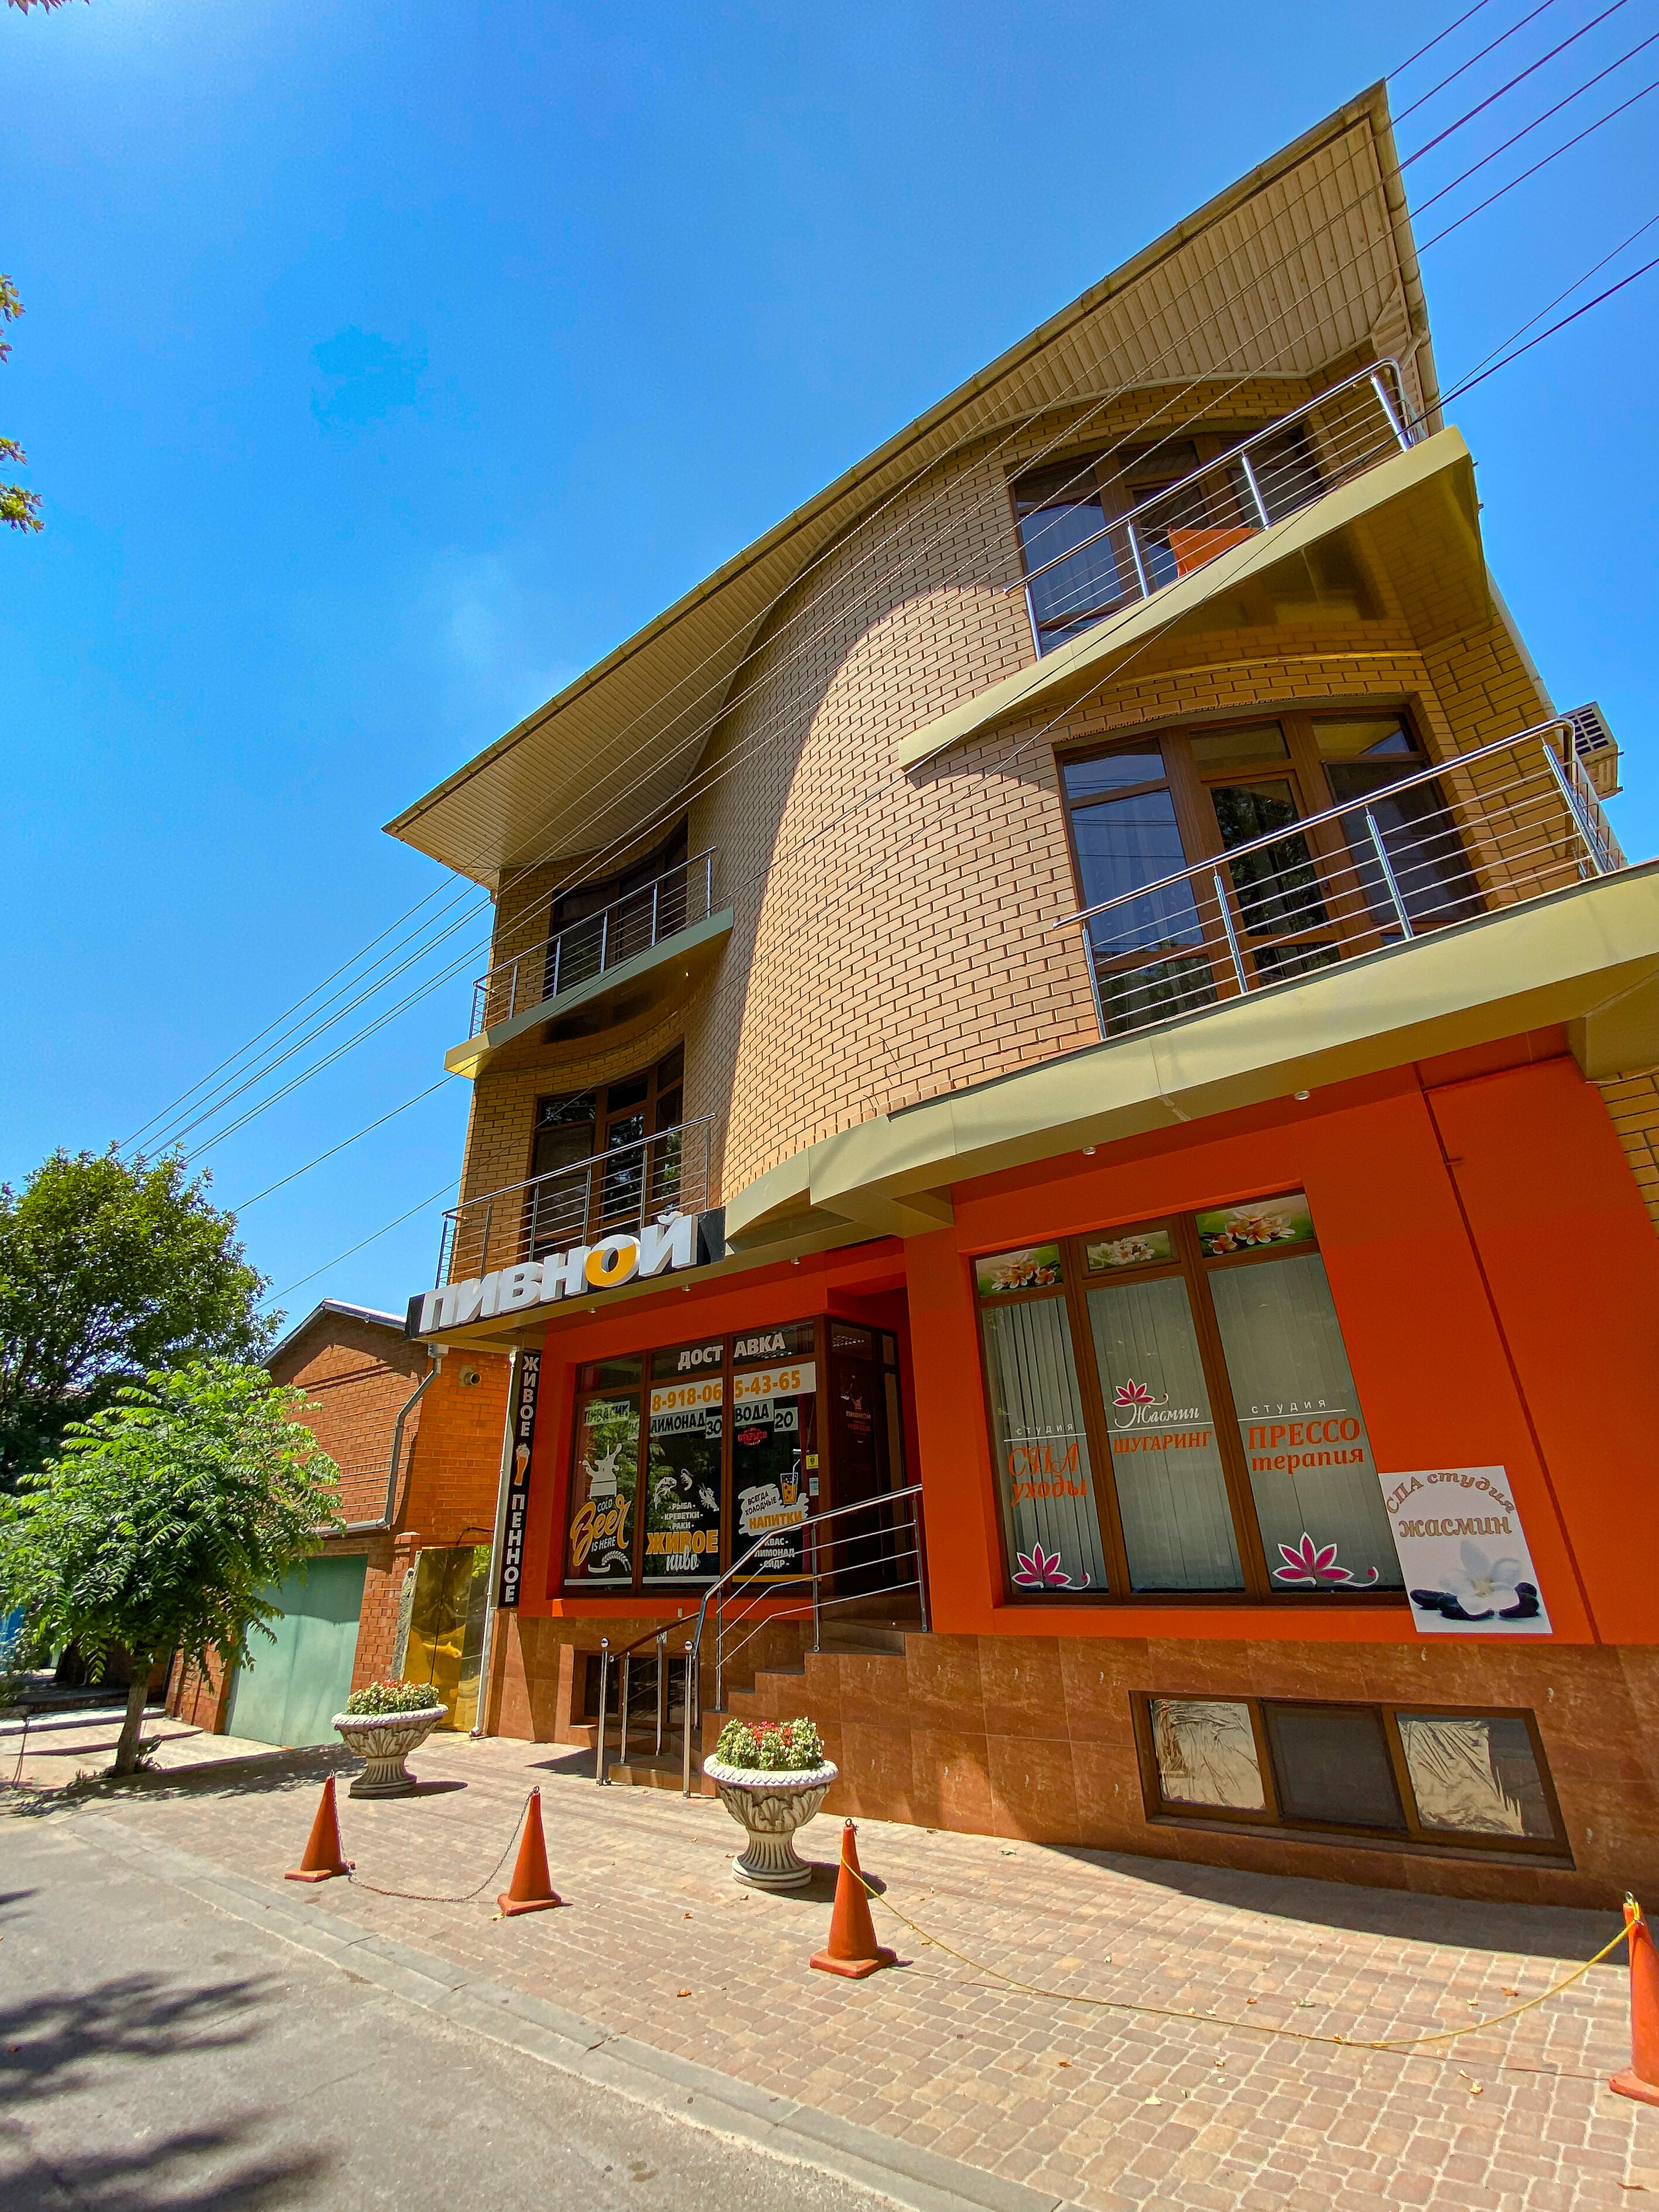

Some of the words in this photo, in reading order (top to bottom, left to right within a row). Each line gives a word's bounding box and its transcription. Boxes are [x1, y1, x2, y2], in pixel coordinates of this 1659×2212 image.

[419, 1211, 698, 1332] ПИВНОЙ
[521, 1355, 539, 1437] ЖИВОЕ
[651, 1411, 705, 1433] ЛИМОНАД
[706, 1418, 721, 1435] 30
[735, 1403, 769, 1423] ВОДА
[775, 1411, 793, 1428] 20
[1114, 1402, 1199, 1428] Жасмин
[1113, 1430, 1212, 1455] ШУГАРИНГ
[1248, 1417, 1360, 1450] ПРЕССО
[1008, 1441, 1080, 1477] СПА
[1251, 1448, 1364, 1475] терапия
[747, 1490, 769, 1506] ВСЕГДА
[1011, 1475, 1087, 1507] уходы
[1386, 1476, 1424, 1515] СПА
[1427, 1471, 1517, 1514] студия
[597, 1499, 613, 1512] COLD
[664, 1511, 700, 1520] КРЕВЕТКИ
[744, 1496, 777, 1516] ХОЛОДНЫЕ
[570, 1494, 632, 1566] Beer
[749, 1510, 803, 1530] НАПИТКИ
[1398, 1515, 1513, 1539] жасмин
[504, 1494, 525, 1602] ПЕННОЕ
[591, 1542, 598, 1552] IS
[598, 1536, 616, 1550] HERE
[645, 1529, 719, 1555] ЖИВОЕ
[754, 1548, 795, 1558] ЛИМОНАД
[666, 1545, 699, 1571] пиво
